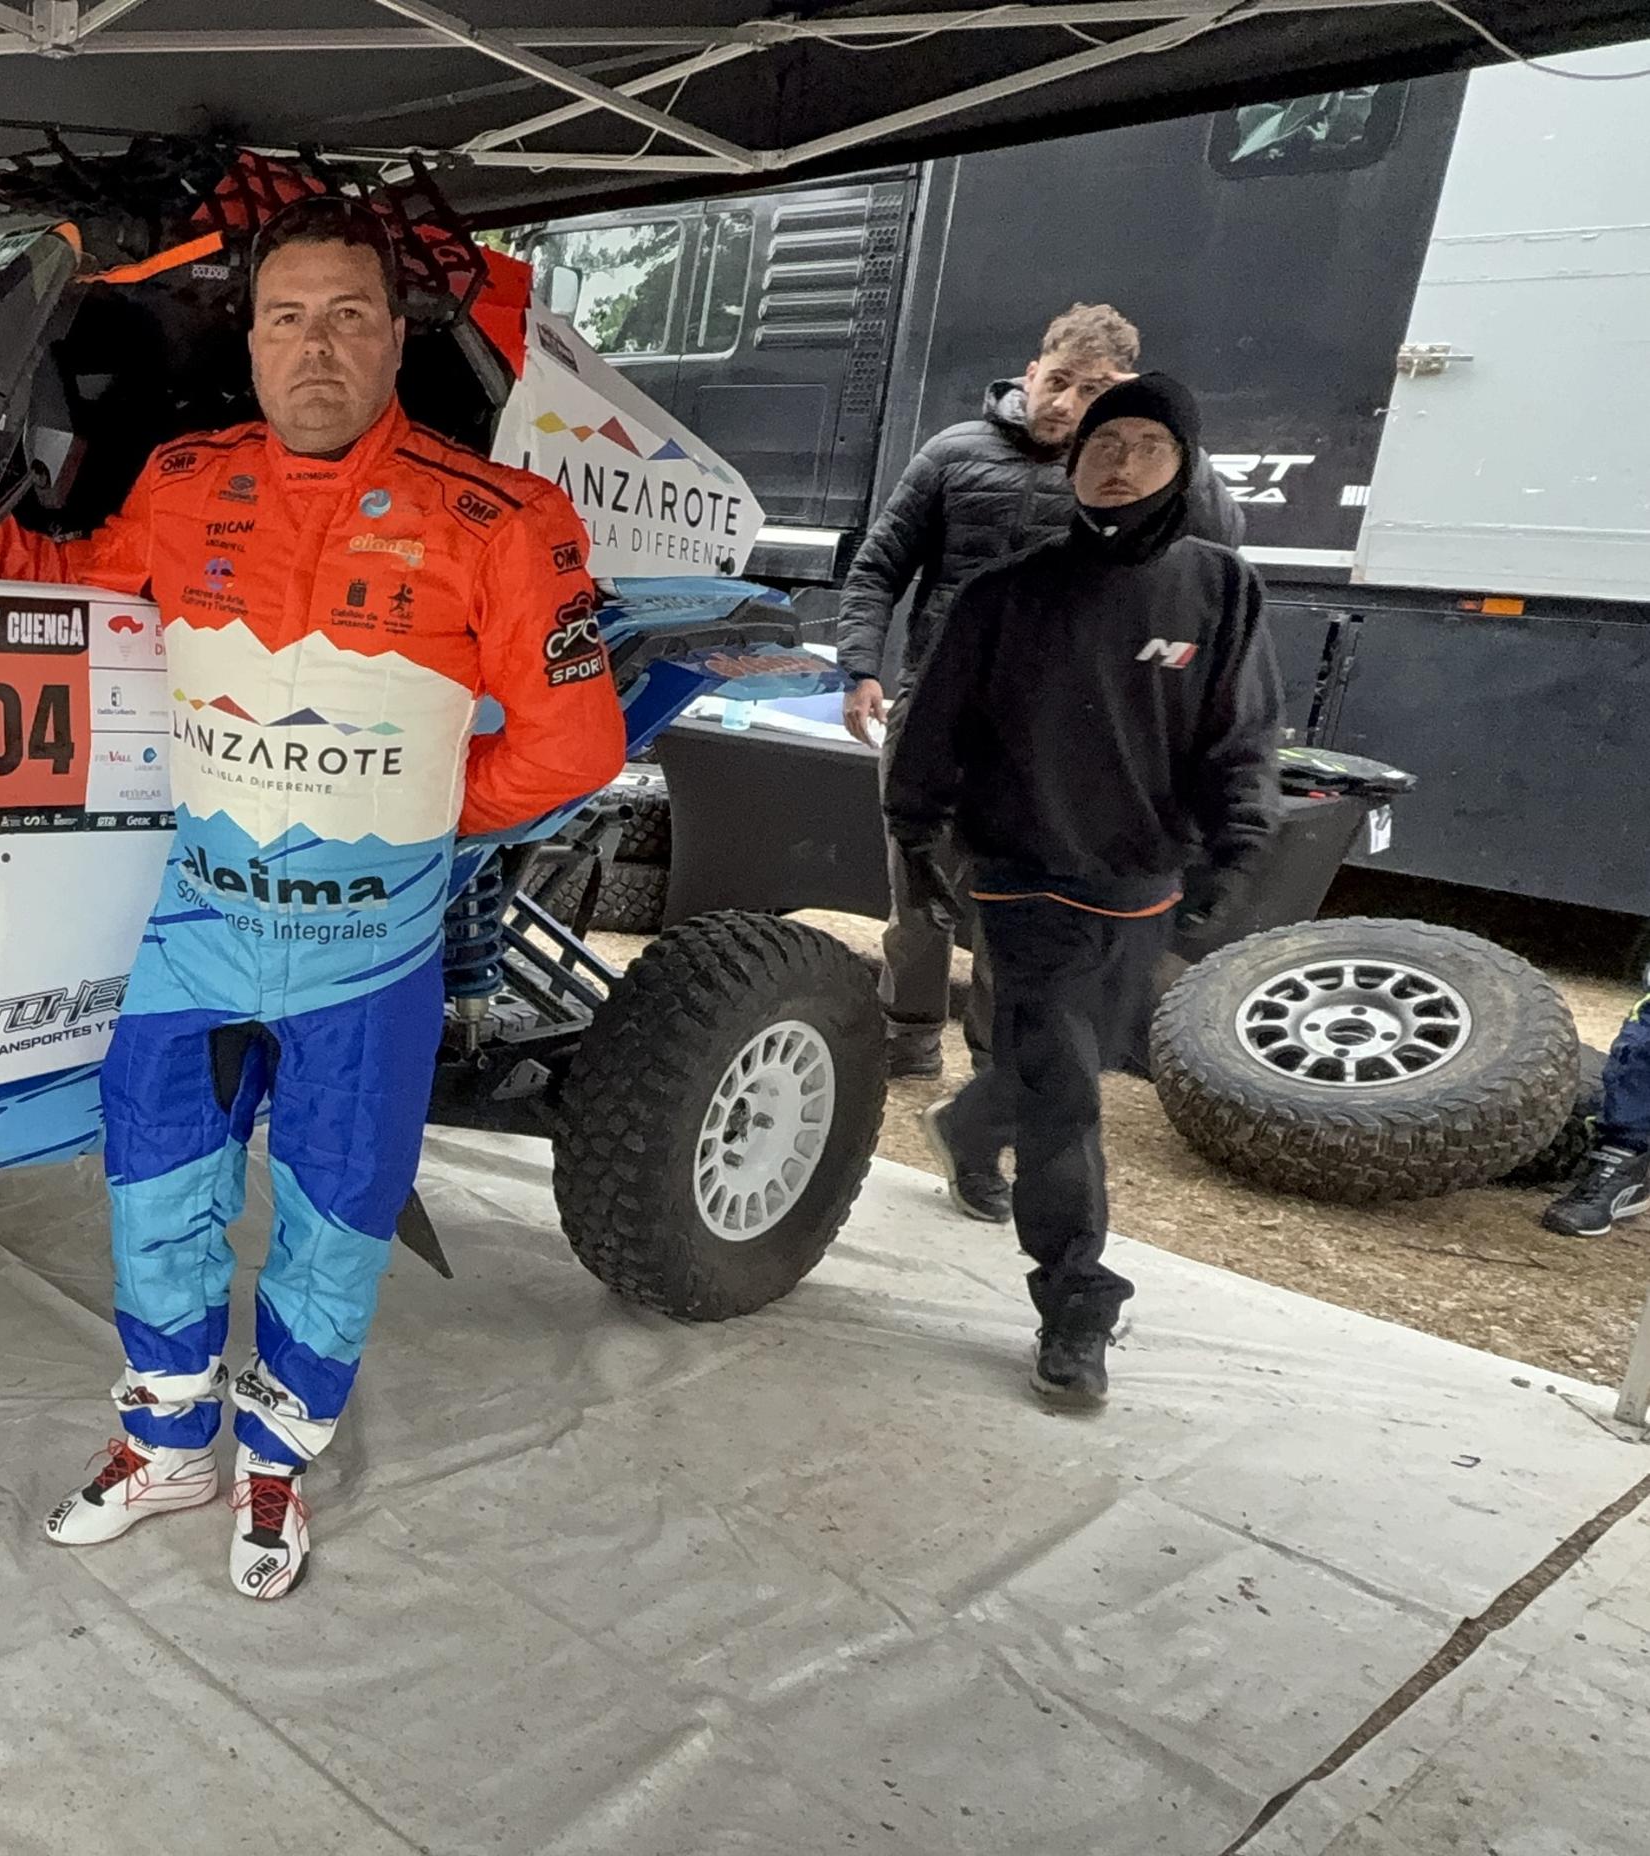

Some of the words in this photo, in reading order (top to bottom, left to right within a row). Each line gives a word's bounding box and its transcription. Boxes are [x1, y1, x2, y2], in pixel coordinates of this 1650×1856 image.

[161, 454, 197, 471] OMP
[457, 494, 499, 521] OMP
[7, 607, 85, 646] CUENCA
[172, 710, 403, 775] LANZAROTE
[216, 770, 244, 784] ISLA
[249, 776, 333, 794] DIFERENTE
[179, 846, 390, 912] aleima
[274, 919, 388, 945] Integrales
[96, 1022, 108, 1033] Y
[246, 1556, 280, 1589] OMP
